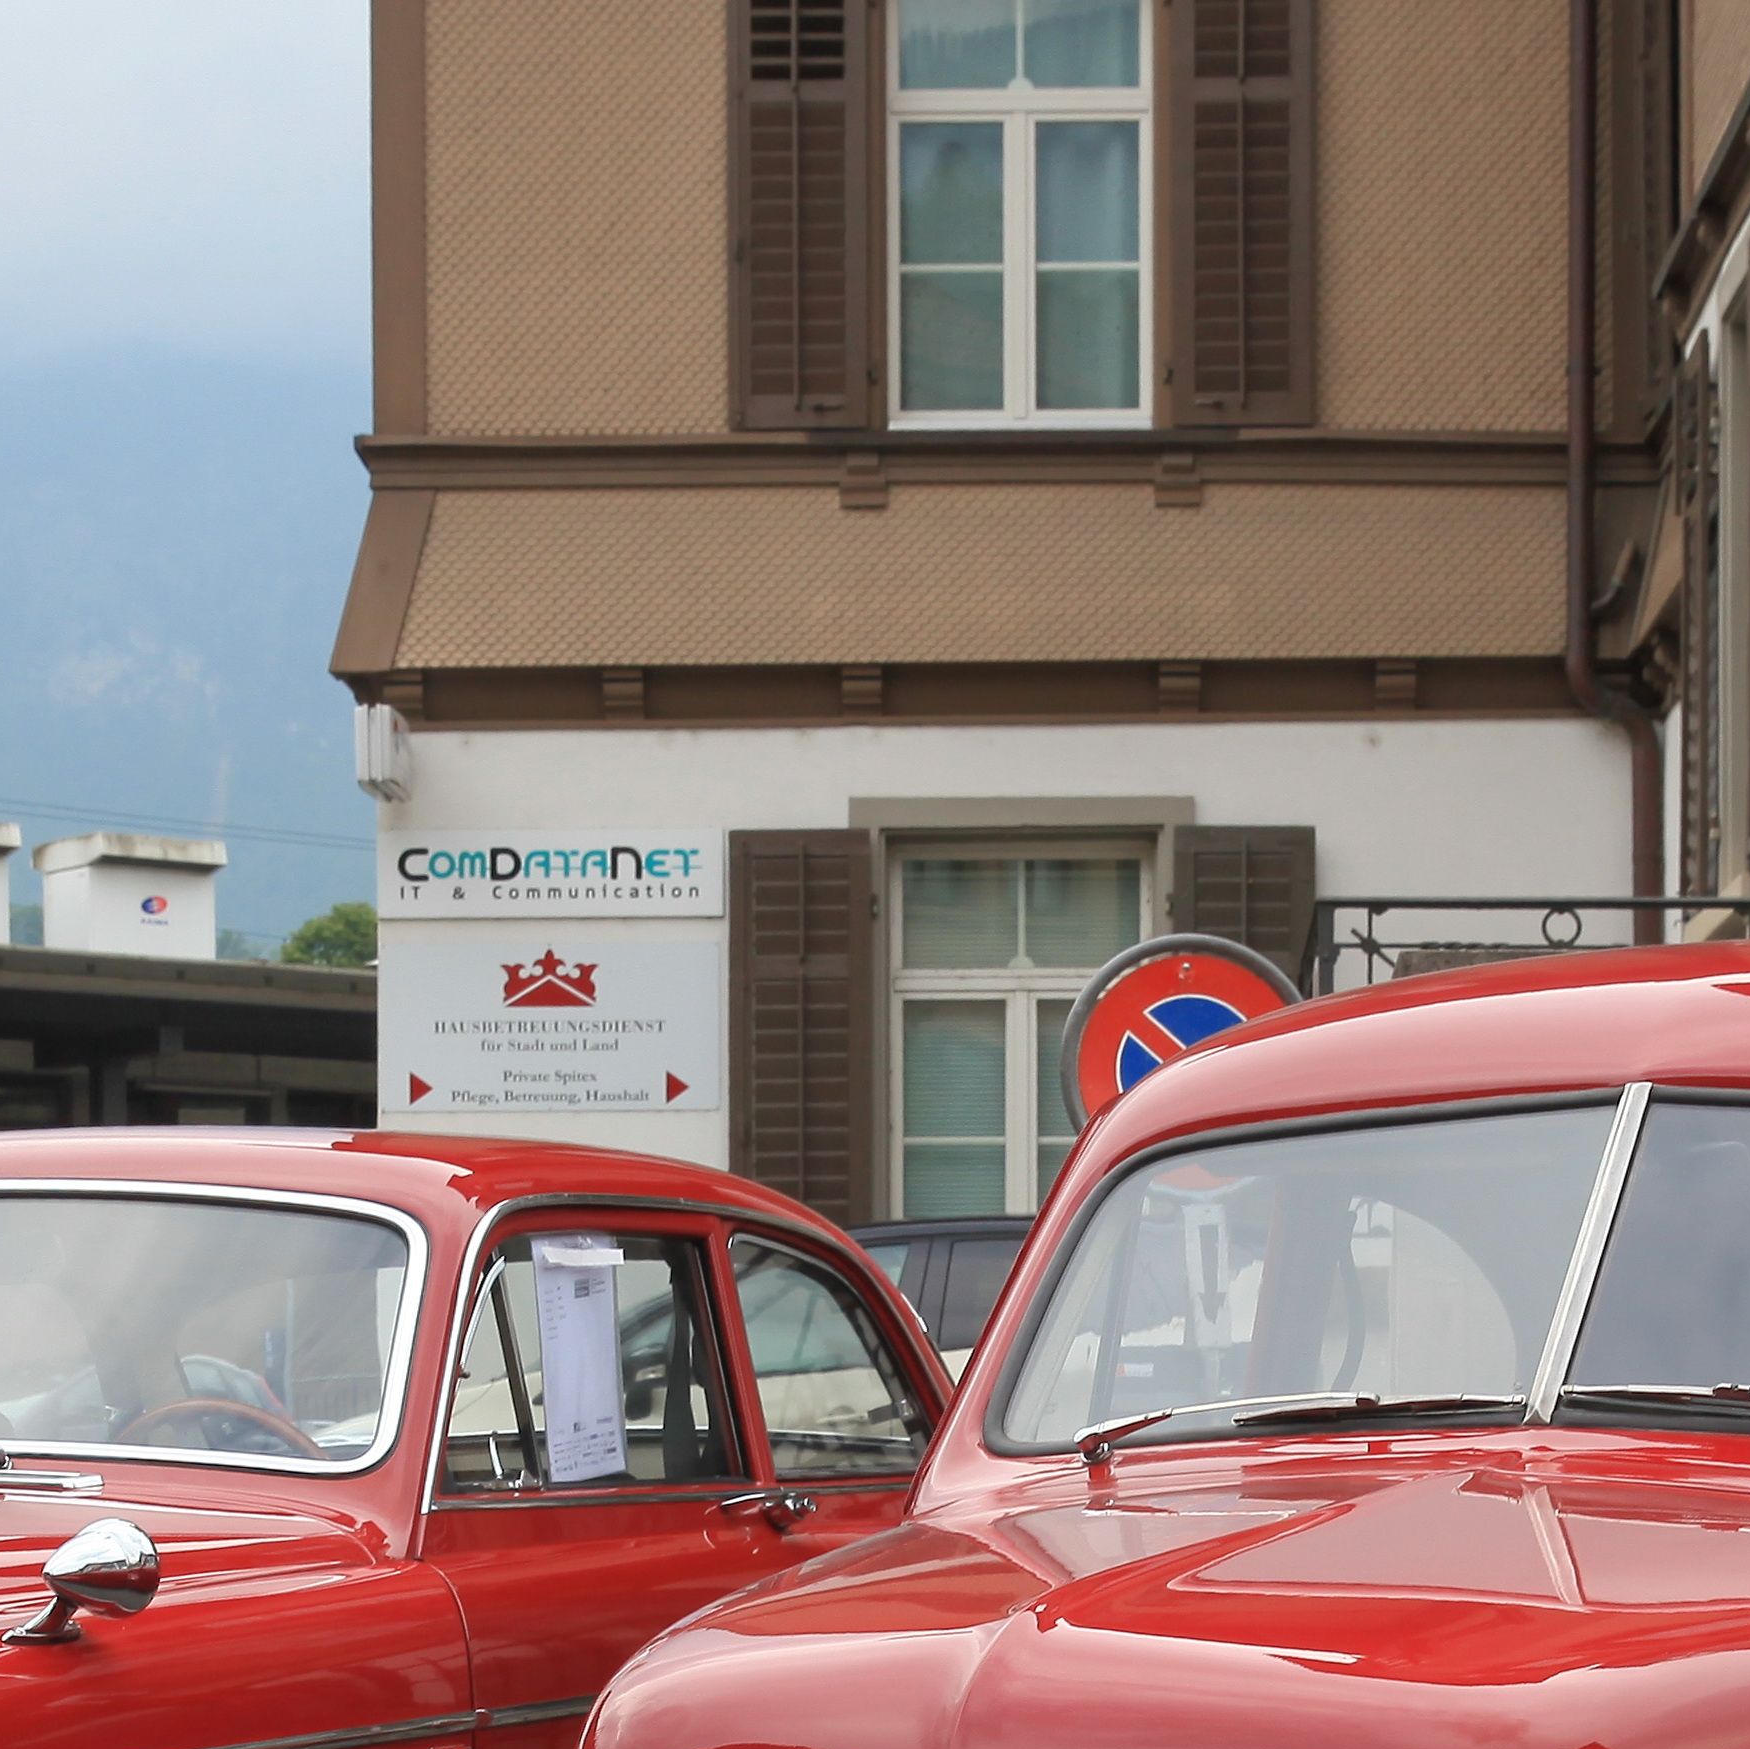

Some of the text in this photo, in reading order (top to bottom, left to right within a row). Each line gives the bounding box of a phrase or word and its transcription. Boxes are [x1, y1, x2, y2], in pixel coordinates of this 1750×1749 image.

[401, 884, 700, 900] IT & Communication
[434, 1019, 666, 1034] HAUSBETREUUNGSDIENST
[480, 1037, 619, 1051] für Stadt und Land
[503, 1069, 597, 1086] Private Spitex
[451, 1089, 650, 1105] Pflege, Betreuung, Haushalt
